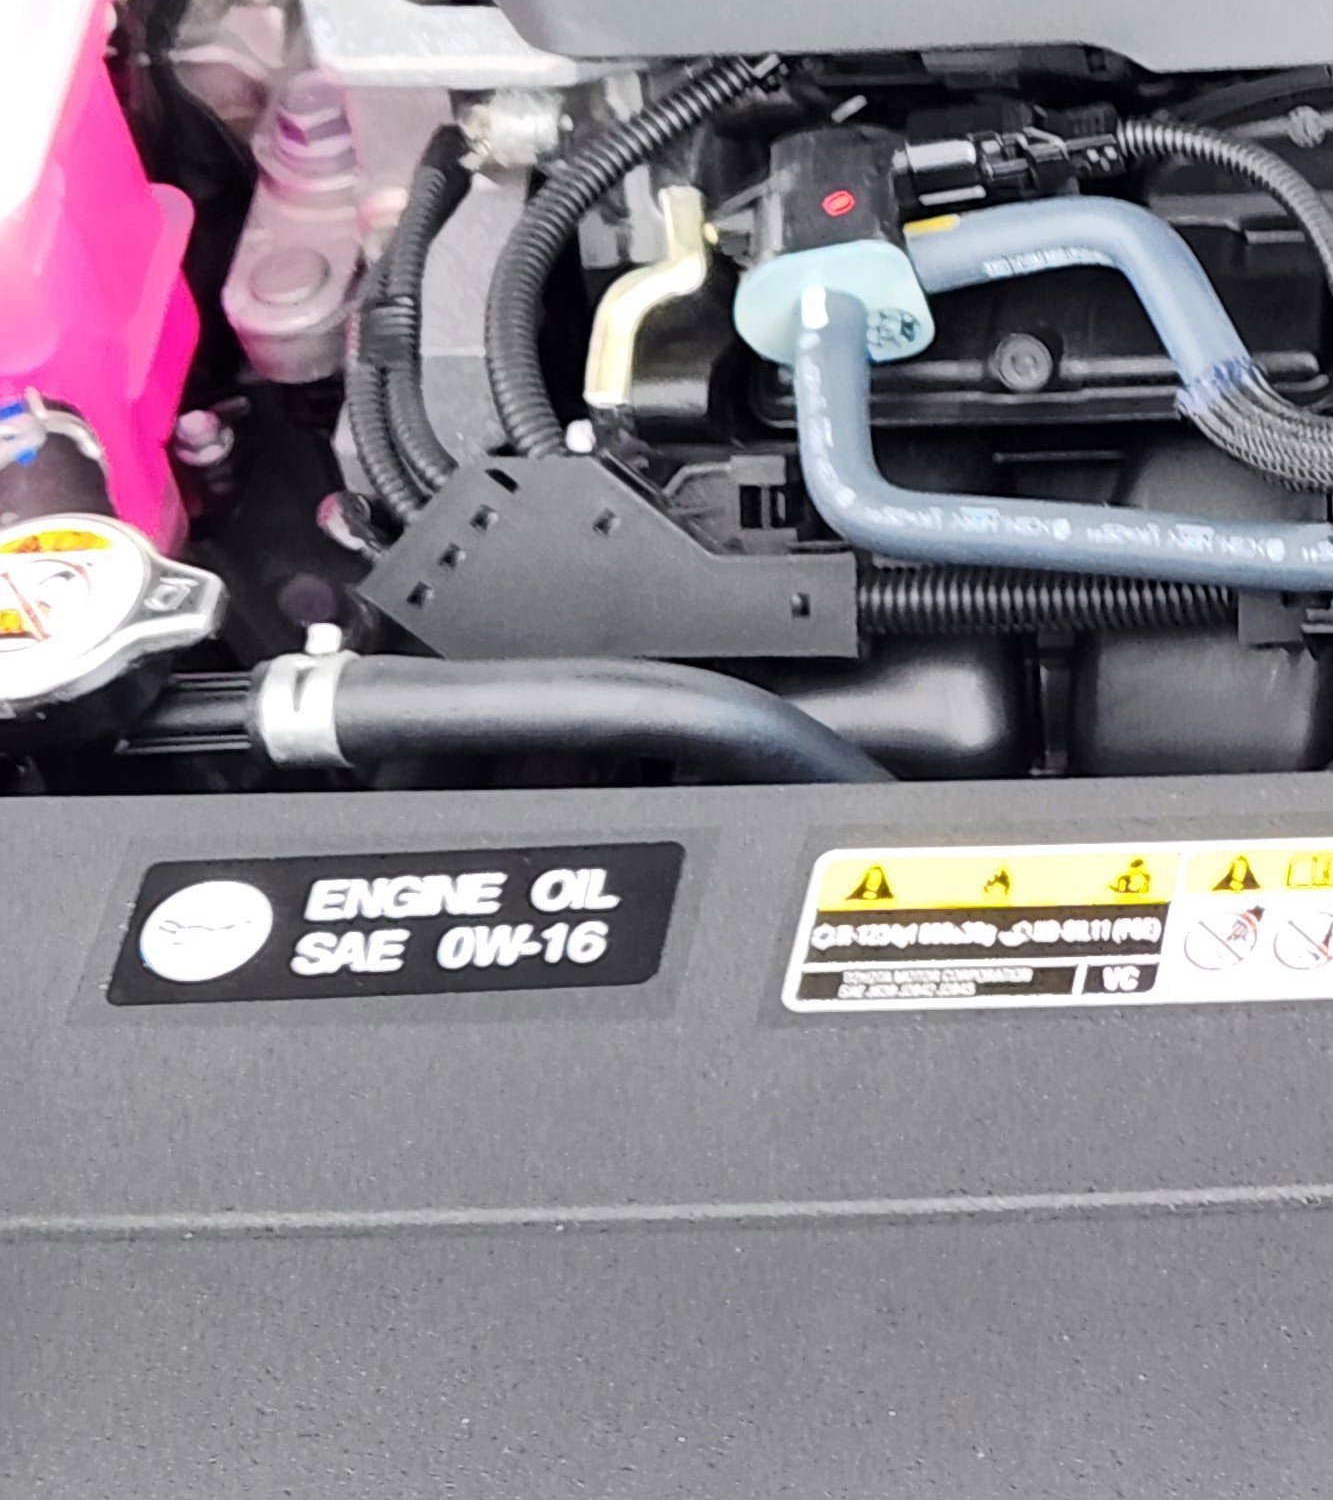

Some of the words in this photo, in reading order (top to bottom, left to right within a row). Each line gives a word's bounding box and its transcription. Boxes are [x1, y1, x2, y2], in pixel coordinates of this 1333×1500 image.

[304, 872, 508, 921] ENGINE
[530, 868, 622, 912] OIL
[290, 928, 411, 975] SAE
[437, 920, 609, 969] 0W-16
[1102, 965, 1141, 992] VC
